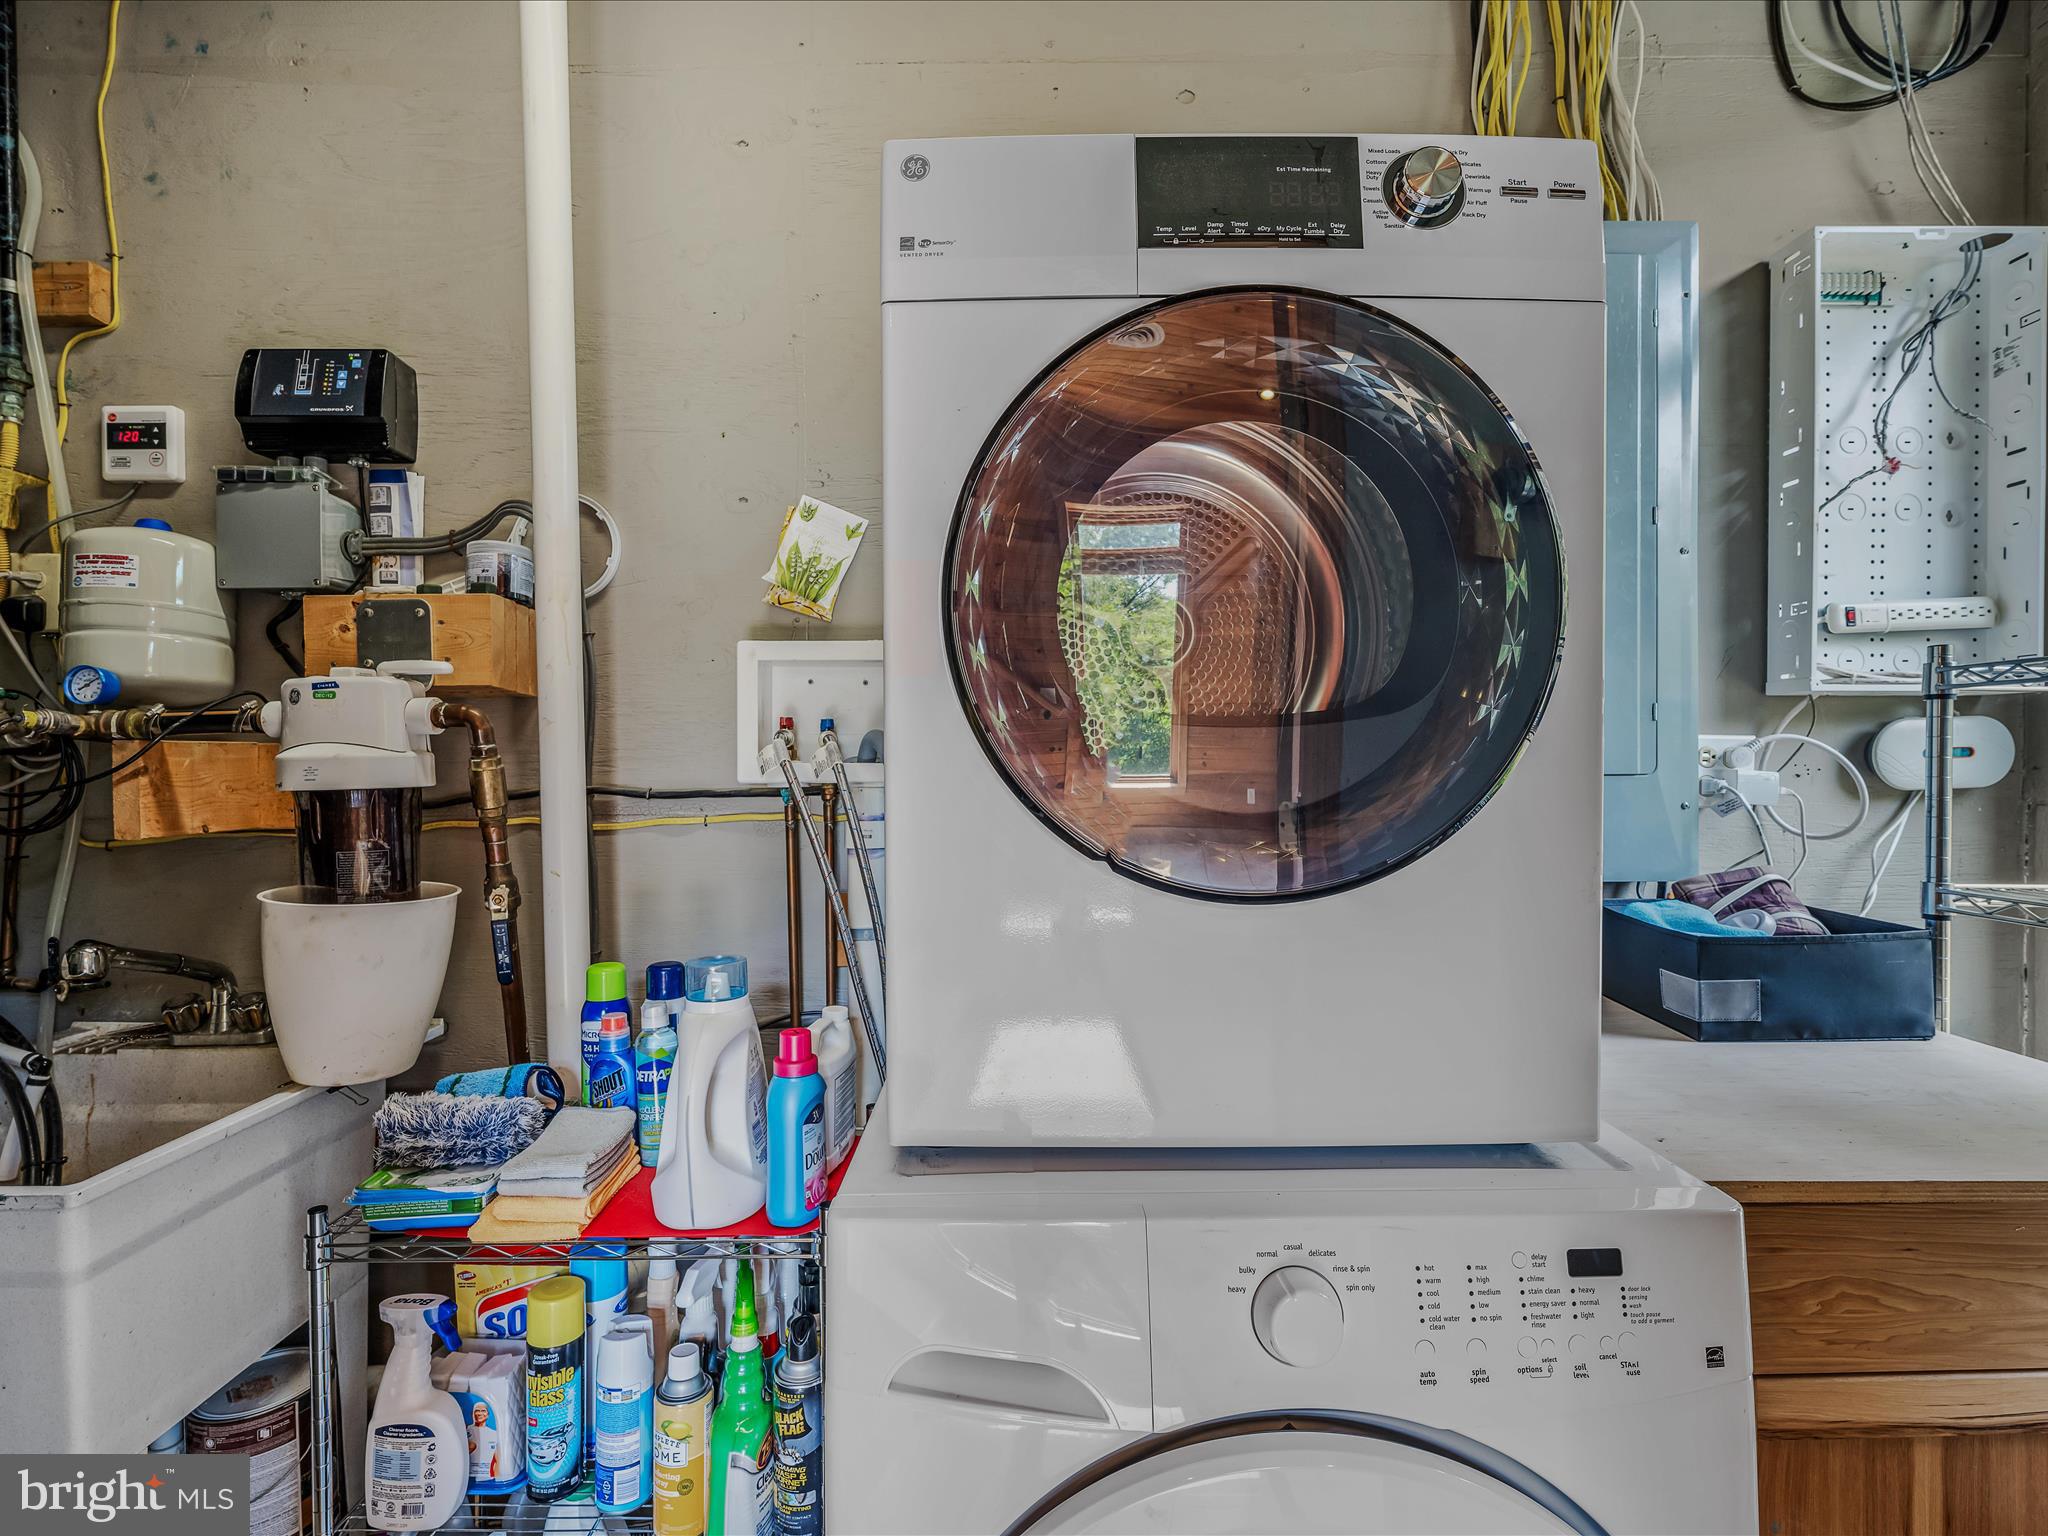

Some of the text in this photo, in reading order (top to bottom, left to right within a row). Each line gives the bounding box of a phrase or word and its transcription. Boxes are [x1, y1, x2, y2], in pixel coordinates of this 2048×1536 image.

[118, 431, 139, 442] 120
[593, 1068, 624, 1098] SHOUT
[1239, 1267, 1256, 1275] bulky
[1357, 1266, 1370, 1274] spin
[476, 1284, 502, 1296] AMERICA'S
[484, 1304, 527, 1338] SO
[528, 1366, 575, 1391] nvisible
[1420, 1378, 1437, 1386] temp
[530, 1388, 564, 1407] Glass
[775, 1408, 804, 1424] BLACK
[779, 1421, 806, 1436] FLAG
[655, 1434, 680, 1448] PLETE
[655, 1447, 680, 1462] OME
[757, 1468, 772, 1490] Clea
